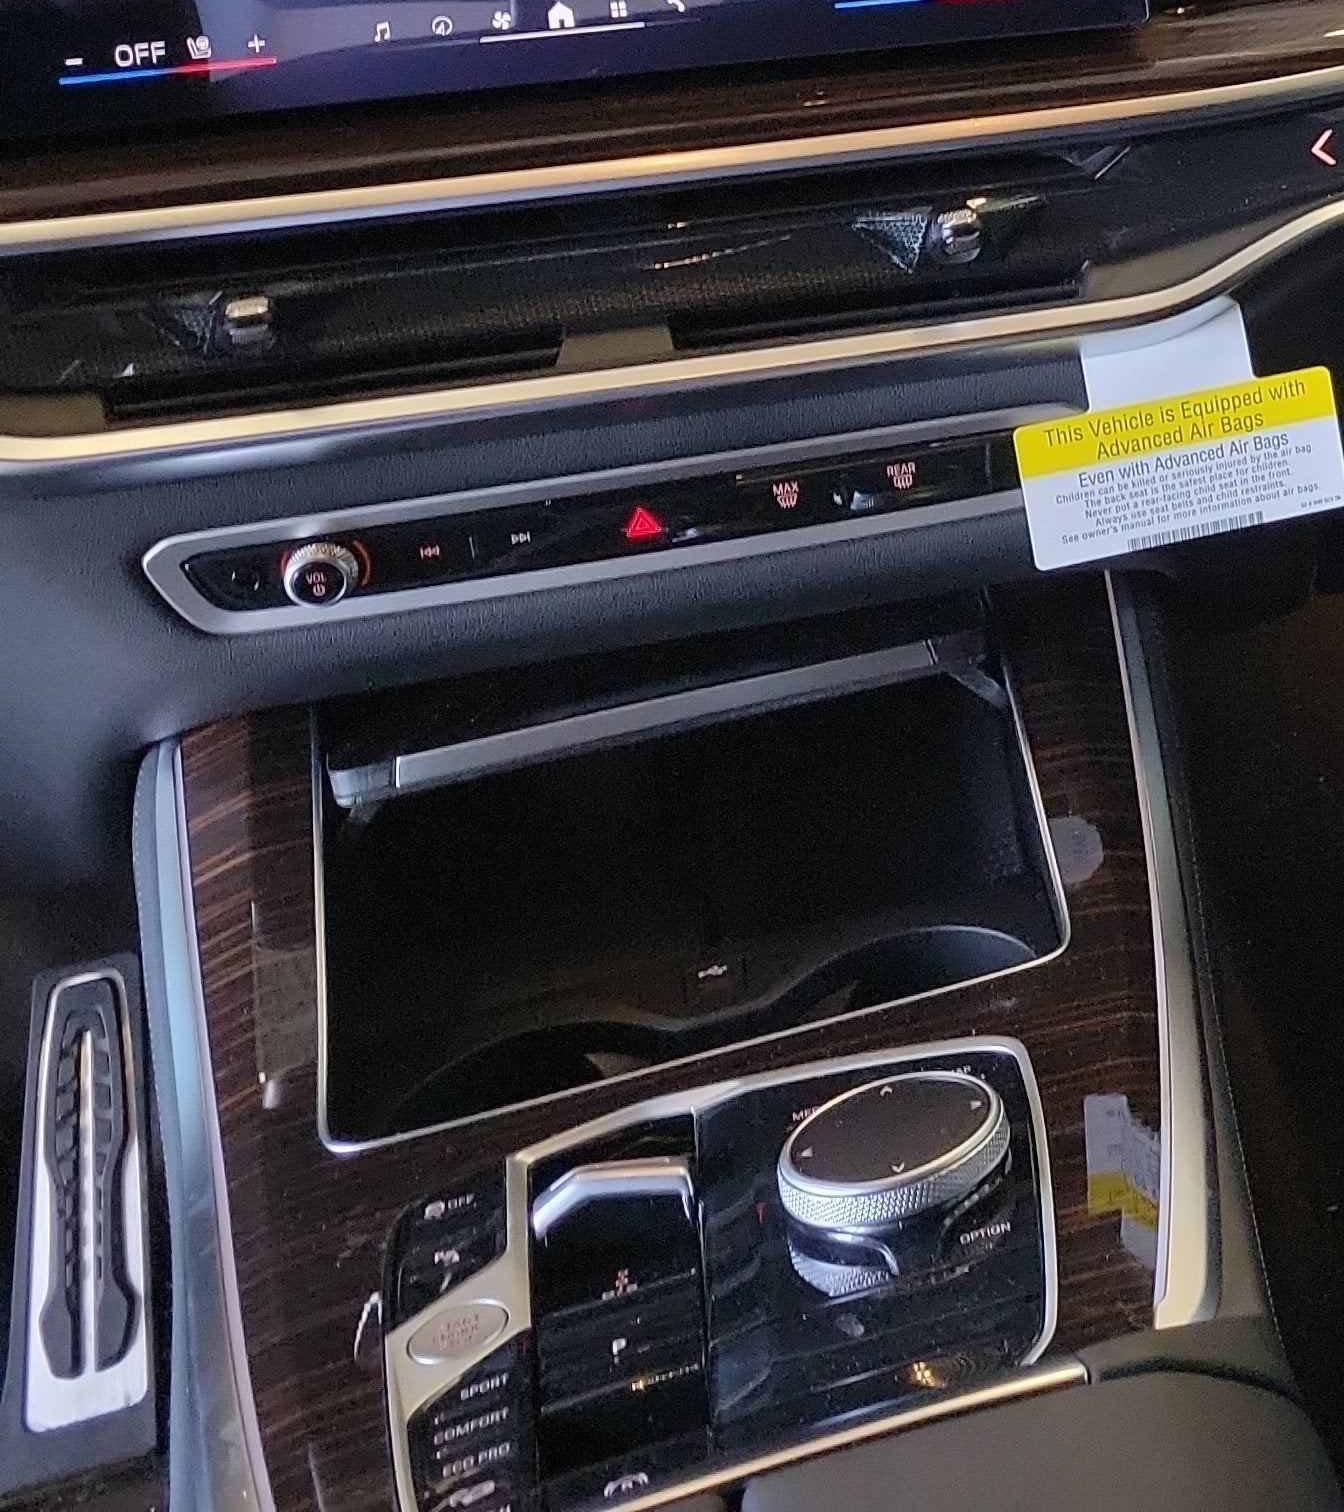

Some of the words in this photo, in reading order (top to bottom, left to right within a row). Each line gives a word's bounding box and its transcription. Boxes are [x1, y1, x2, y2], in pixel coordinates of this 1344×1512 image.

[114, 40, 167, 69] OFF
[1043, 424, 1084, 448] This
[1088, 410, 1154, 438] Vehicle
[1159, 406, 1176, 424] is
[1181, 386, 1263, 422] Equipped
[1268, 379, 1306, 402] with
[1097, 425, 1184, 461] Advanced
[1190, 420, 1215, 441] Air
[1220, 412, 1264, 434] Bags
[886, 461, 916, 478] REAR
[1055, 489, 1096, 505] Children
[1098, 485, 1119, 496] can
[1120, 481, 1129, 491] be
[1131, 474, 1157, 489] killed
[1159, 472, 1169, 482] or
[1172, 464, 1213, 481] seriously
[1215, 456, 1248, 473] injured
[1250, 452, 1262, 464] by
[1263, 448, 1279, 461] the
[1280, 445, 1293, 457] air
[1078, 469, 1115, 488] Even
[1118, 459, 1151, 479] with
[1154, 443, 1225, 473] Advanced
[1229, 439, 1249, 457] Air
[1253, 433, 1290, 451] Bags
[772, 480, 800, 496] MAX
[1084, 498, 1102, 509] The
[1104, 492, 1127, 505] back
[1129, 487, 1149, 500] seat
[1151, 484, 1160, 495] is
[1161, 481, 1177, 492] the
[1179, 475, 1207, 489] safest
[1209, 470, 1234, 484] place
[1235, 466, 1249, 477] for
[1084, 506, 1112, 520] Never
[1115, 502, 1131, 515] put
[1141, 489, 1192, 507] rear-facing
[1193, 483, 1216, 496] child
[1218, 478, 1238, 490] seat
[1240, 475, 1249, 486] in
[1251, 472, 1267, 484] the
[1061, 533, 1080, 545] See
[1081, 525, 1119, 541] owner's
[1121, 517, 1155, 531] manual
[1157, 514, 1171, 525] for
[1172, 508, 1198, 521] more
[1199, 497, 1252, 515] information
[1254, 491, 1281, 504] about
[1282, 486, 1295, 498] air
[1095, 514, 1129, 528] Always
[1130, 509, 1147, 520] use
[1150, 503, 1170, 516] seat
[1171, 497, 1194, 511] belts
[1196, 493, 1214, 506] and
[1215, 488, 1239, 502] child
[305, 571, 327, 585] VOL
[959, 1220, 1013, 1246] OPTION
[460, 1372, 509, 1401] SPORT
[433, 1406, 510, 1446] COMFORT
[442, 1456, 475, 1479] ECO
[477, 1441, 511, 1465] PRO
